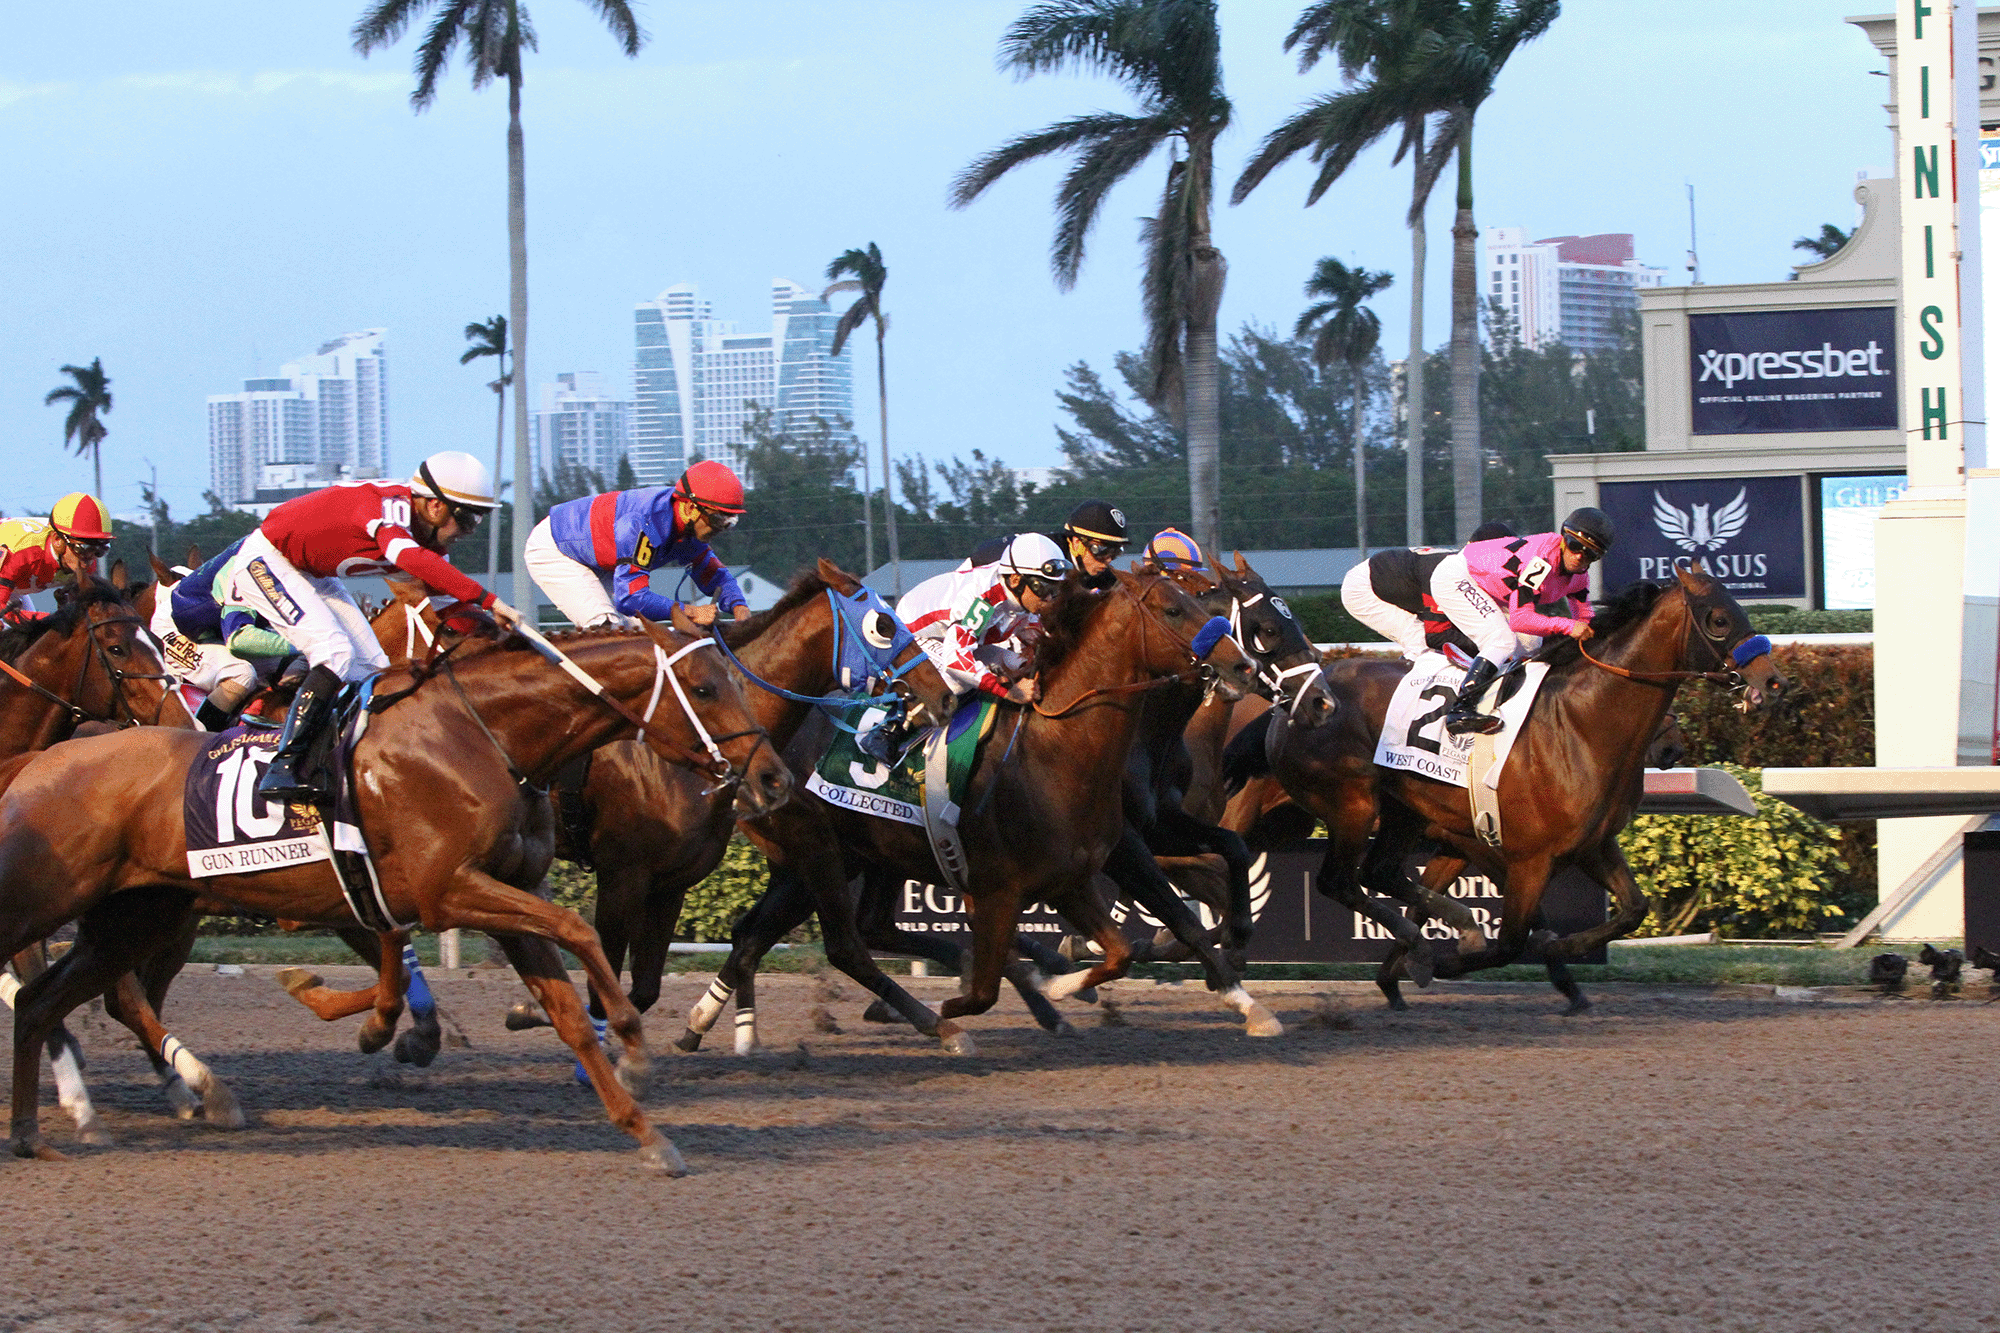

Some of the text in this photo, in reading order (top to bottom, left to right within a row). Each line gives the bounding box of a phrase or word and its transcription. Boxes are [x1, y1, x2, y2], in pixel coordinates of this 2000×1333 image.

[1914, 0, 1947, 440] FINISH
[382, 498, 411, 528] 10
[637, 535, 652, 566] 6
[1525, 561, 1545, 587] 2
[967, 601, 989, 631] 5
[1406, 685, 1460, 755] 2
[1385, 751, 1414, 767] WEST
[1417, 758, 1461, 781] COAST
[216, 745, 285, 843] 10
[819, 784, 913, 819] COLLECTED
[202, 842, 311, 871] GUN RUNNER
[932, 922, 960, 931] CUP
